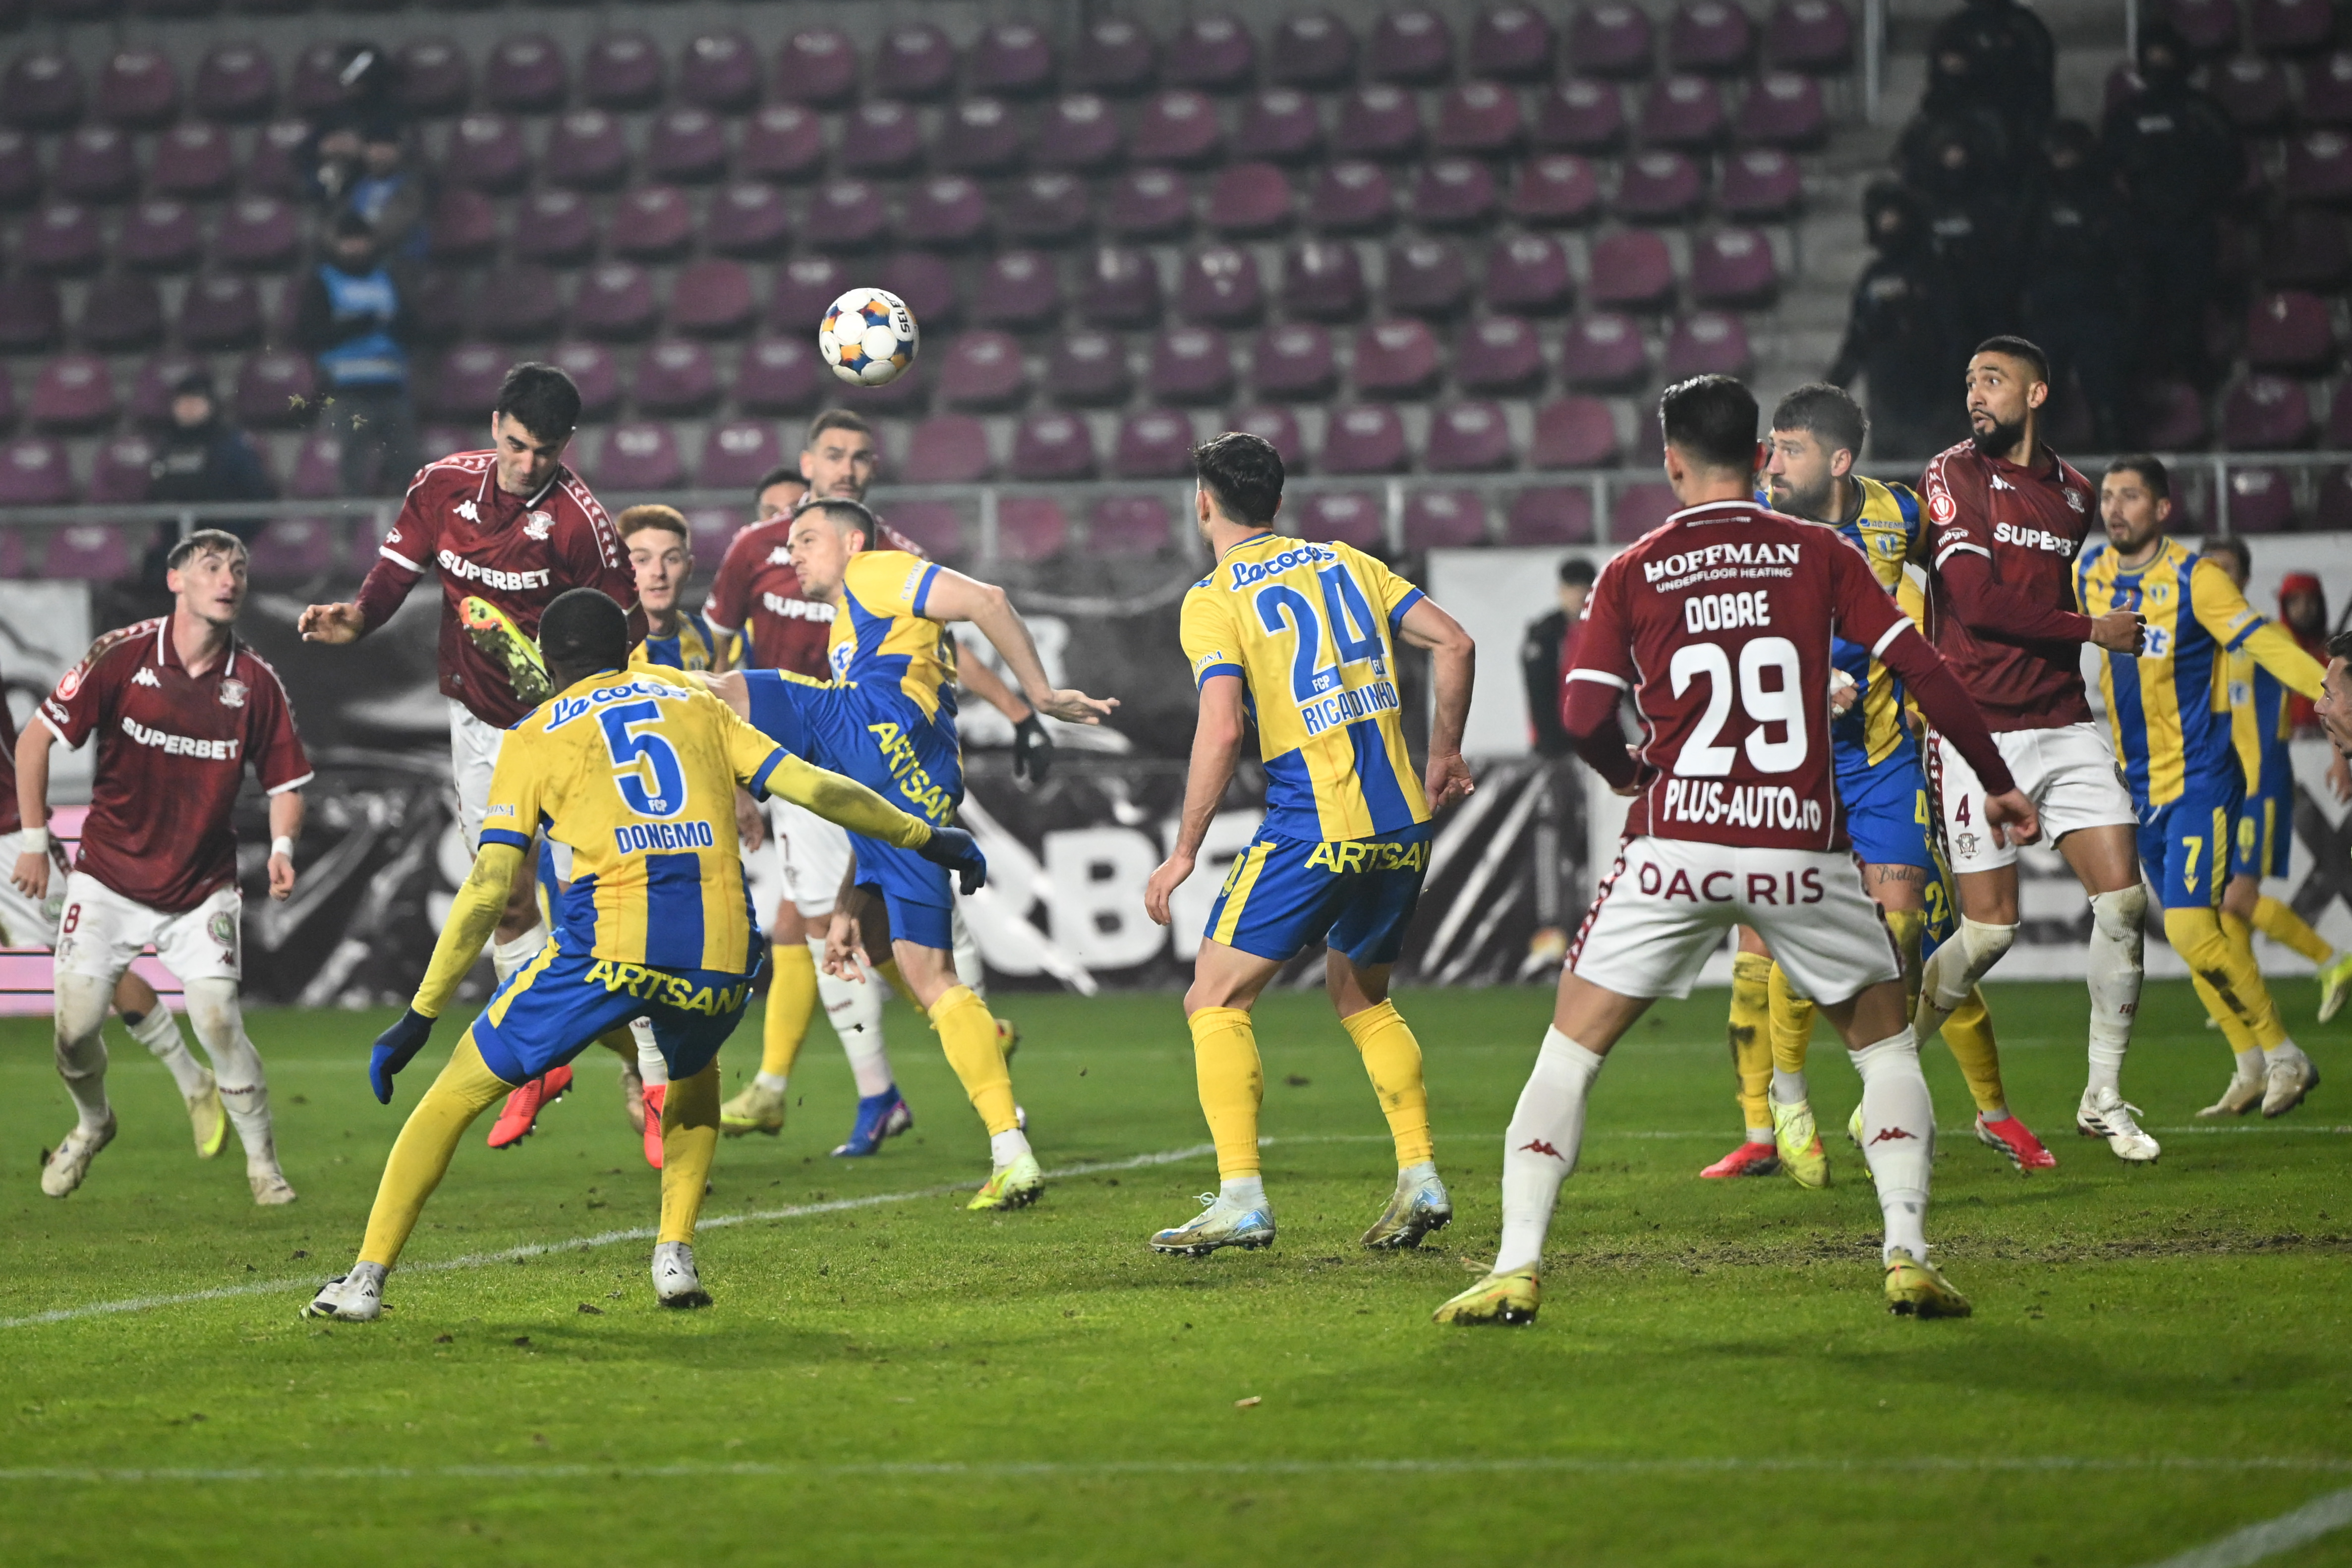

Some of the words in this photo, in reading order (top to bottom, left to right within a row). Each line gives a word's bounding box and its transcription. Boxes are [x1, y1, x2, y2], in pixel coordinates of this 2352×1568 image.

[1994, 522, 2076, 557] SUPERB
[437, 549, 550, 591] SUPERBET
[1643, 543, 1801, 583] HOFFMAN
[1656, 567, 1737, 593] UNDERFLOOR
[1740, 567, 1793, 578] HEATING
[763, 592, 838, 622] SUPER
[1685, 590, 1771, 634] DOBRE
[1252, 560, 1389, 708] 24
[1312, 674, 1330, 692] FCP
[1670, 637, 1808, 777] 29
[122, 716, 239, 760] SUPERBET
[593, 698, 688, 820] 5
[647, 799, 668, 812] FCP
[1663, 779, 1822, 833] PLUS-AUTO.ro
[1954, 792, 1971, 829] 4
[614, 820, 714, 855] DONGMO
[2182, 836, 2203, 875] 7
[1639, 861, 1825, 905] DACRIS
[1925, 881, 1949, 923] 2
[63, 902, 81, 934] 8
